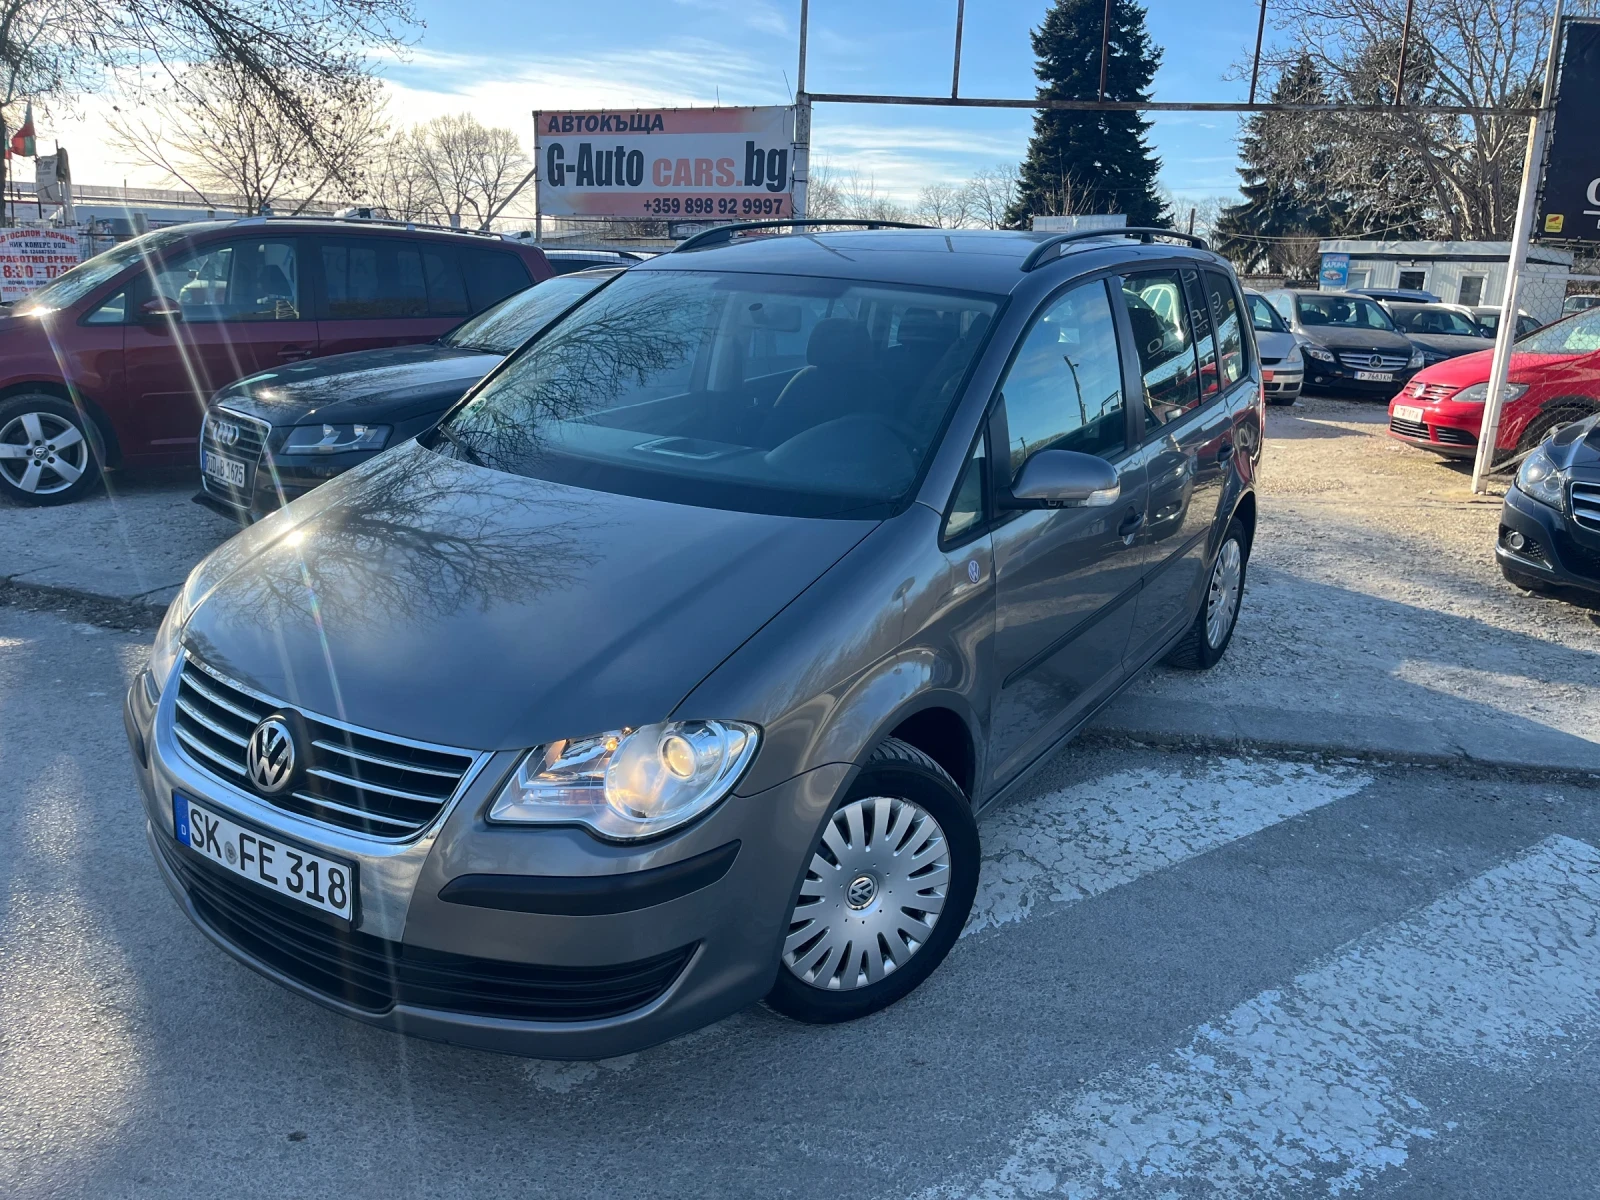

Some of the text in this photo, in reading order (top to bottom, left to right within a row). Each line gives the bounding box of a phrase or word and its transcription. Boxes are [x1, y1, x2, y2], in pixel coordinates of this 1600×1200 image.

[548, 113, 664, 134] АВТОКЪЩА
[547, 142, 644, 187] G-Auto
[643, 197, 783, 215] +359 898 92 9997
[0, 255, 79, 263] РАБОТНО ВРЕМЕ
[3, 265, 34, 278] 8:30
[190, 808, 347, 910] SK FE 318
